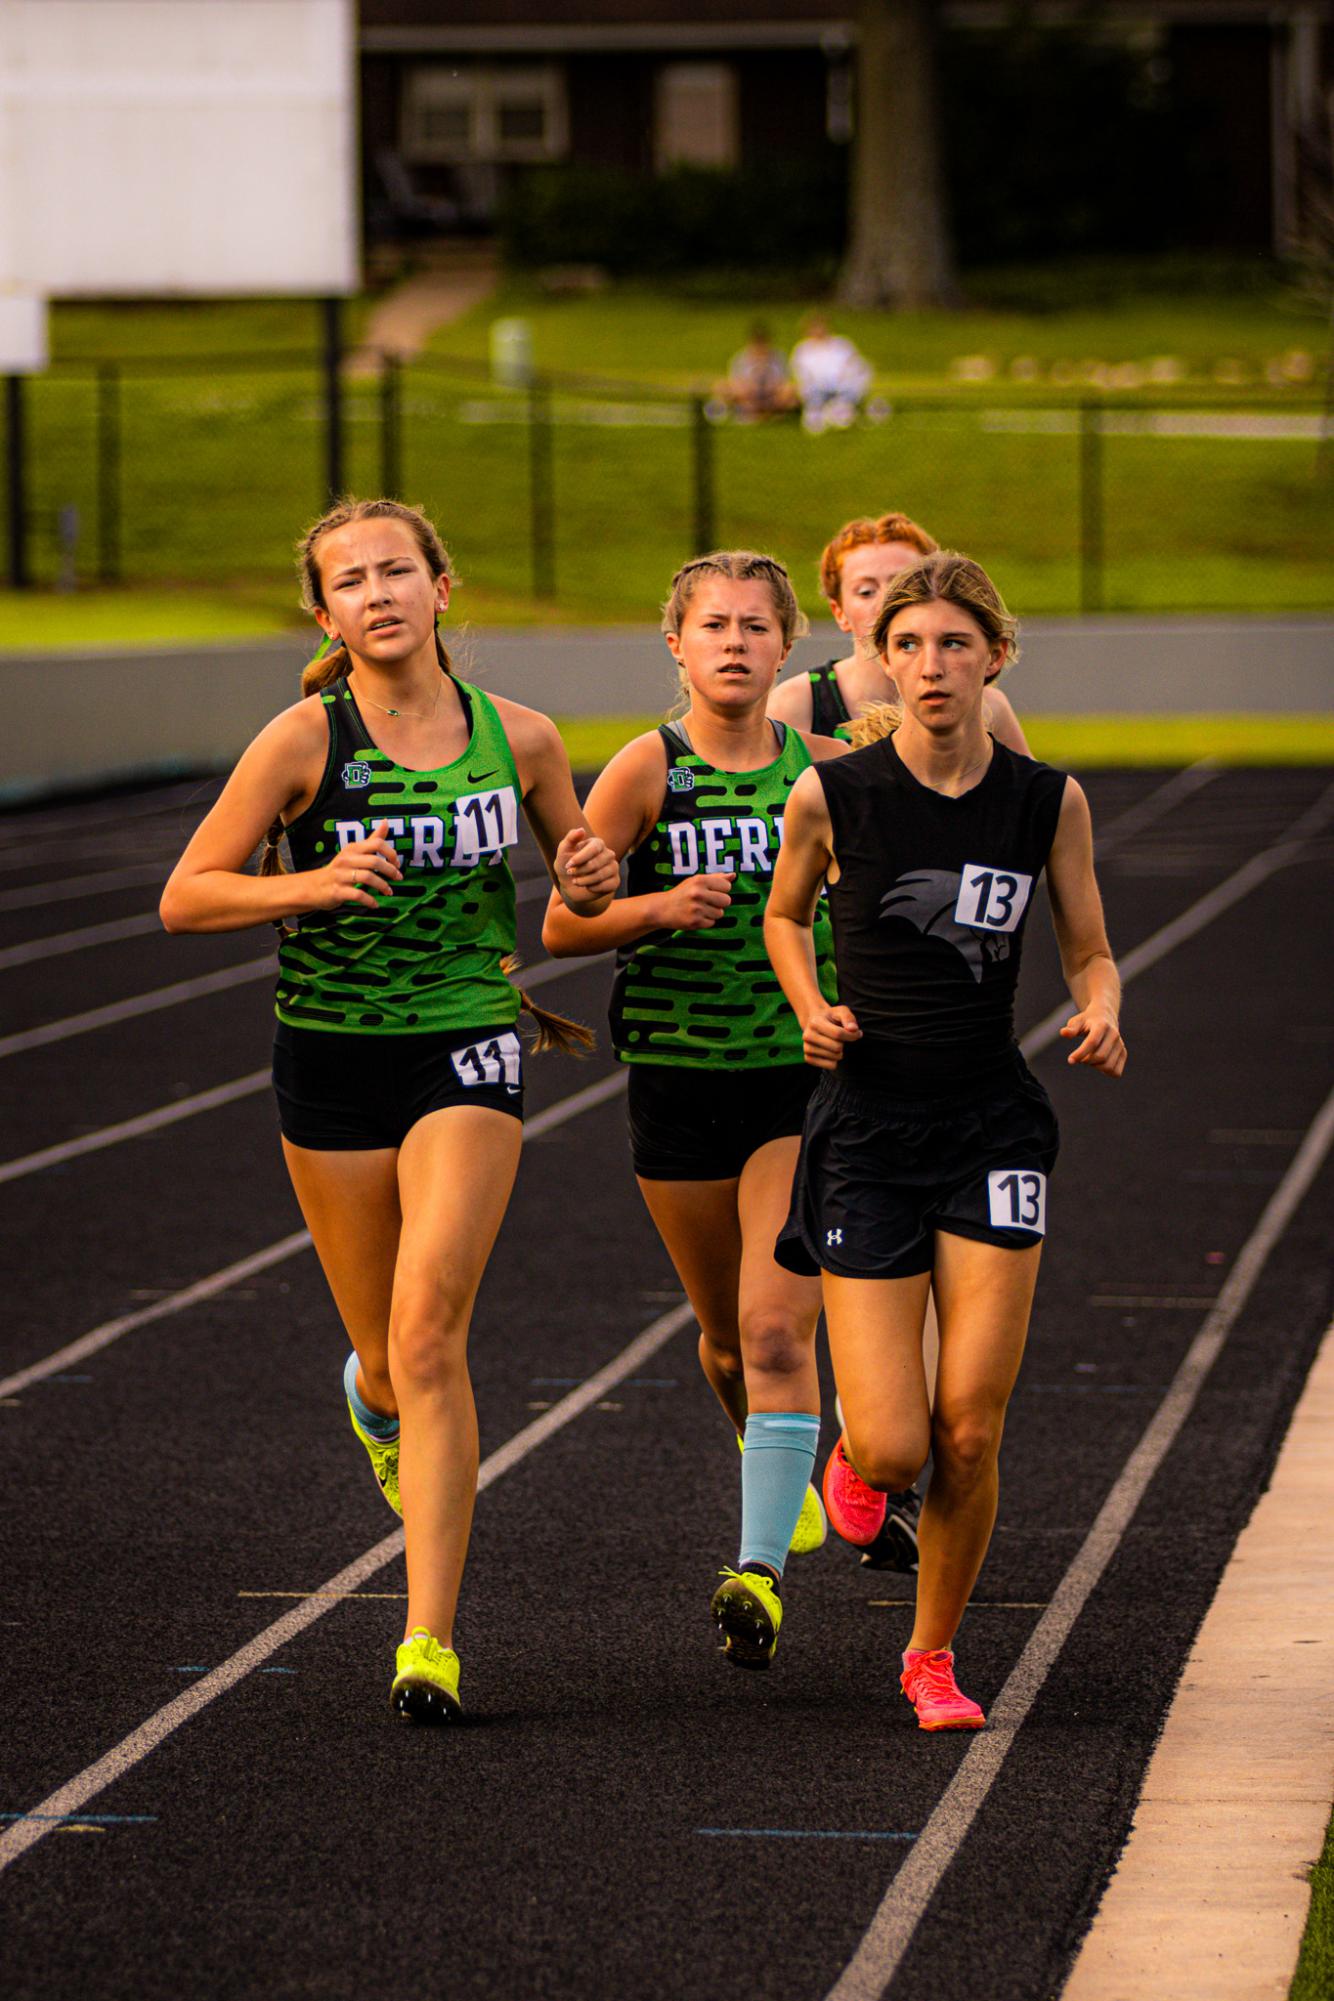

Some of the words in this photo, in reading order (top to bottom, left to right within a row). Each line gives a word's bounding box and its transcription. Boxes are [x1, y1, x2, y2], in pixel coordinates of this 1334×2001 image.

[335, 816, 503, 869] DER
[463, 793, 504, 848] 11
[970, 871, 1018, 927] 13
[459, 1040, 506, 1084] 11
[997, 1174, 1041, 1226] 13
